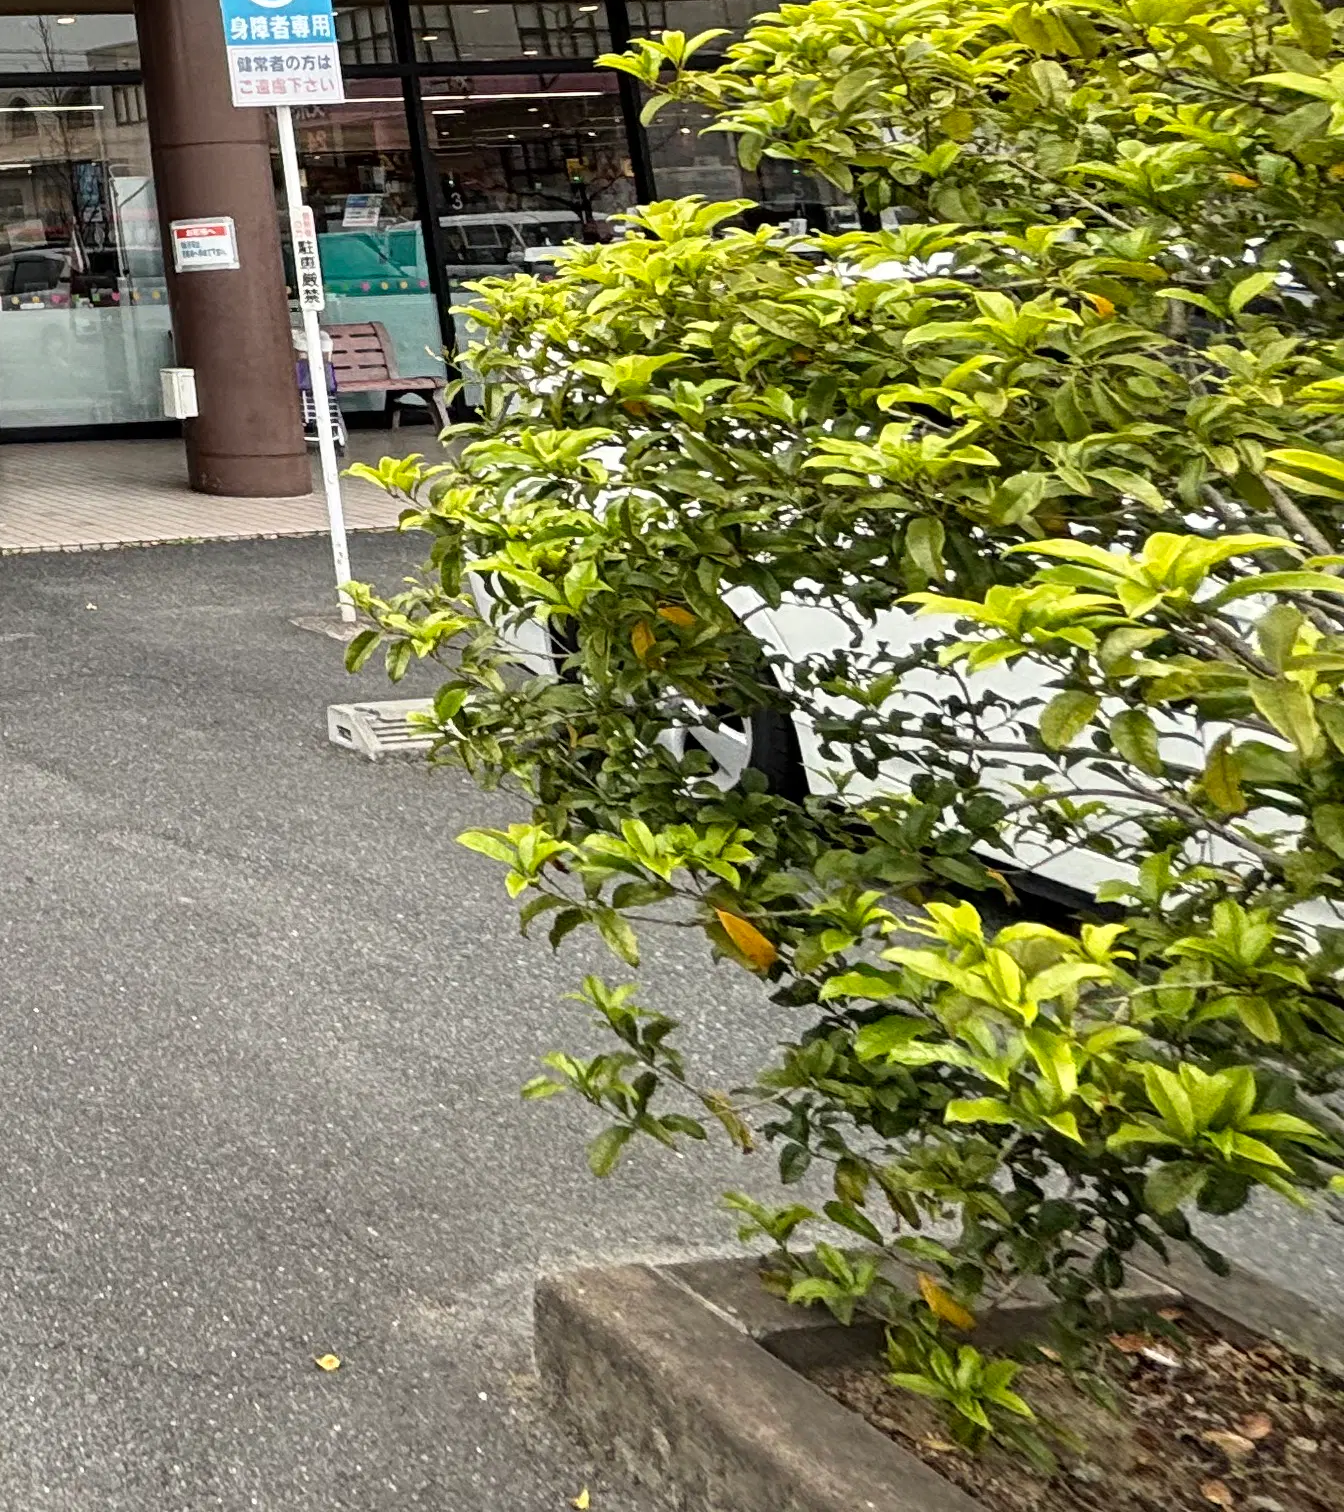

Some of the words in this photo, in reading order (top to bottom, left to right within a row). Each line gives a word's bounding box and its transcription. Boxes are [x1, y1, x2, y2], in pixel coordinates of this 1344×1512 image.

[230, 14, 331, 40] 身障者専用
[237, 54, 332, 73] 健常者の方は
[451, 192, 463, 210] 3
